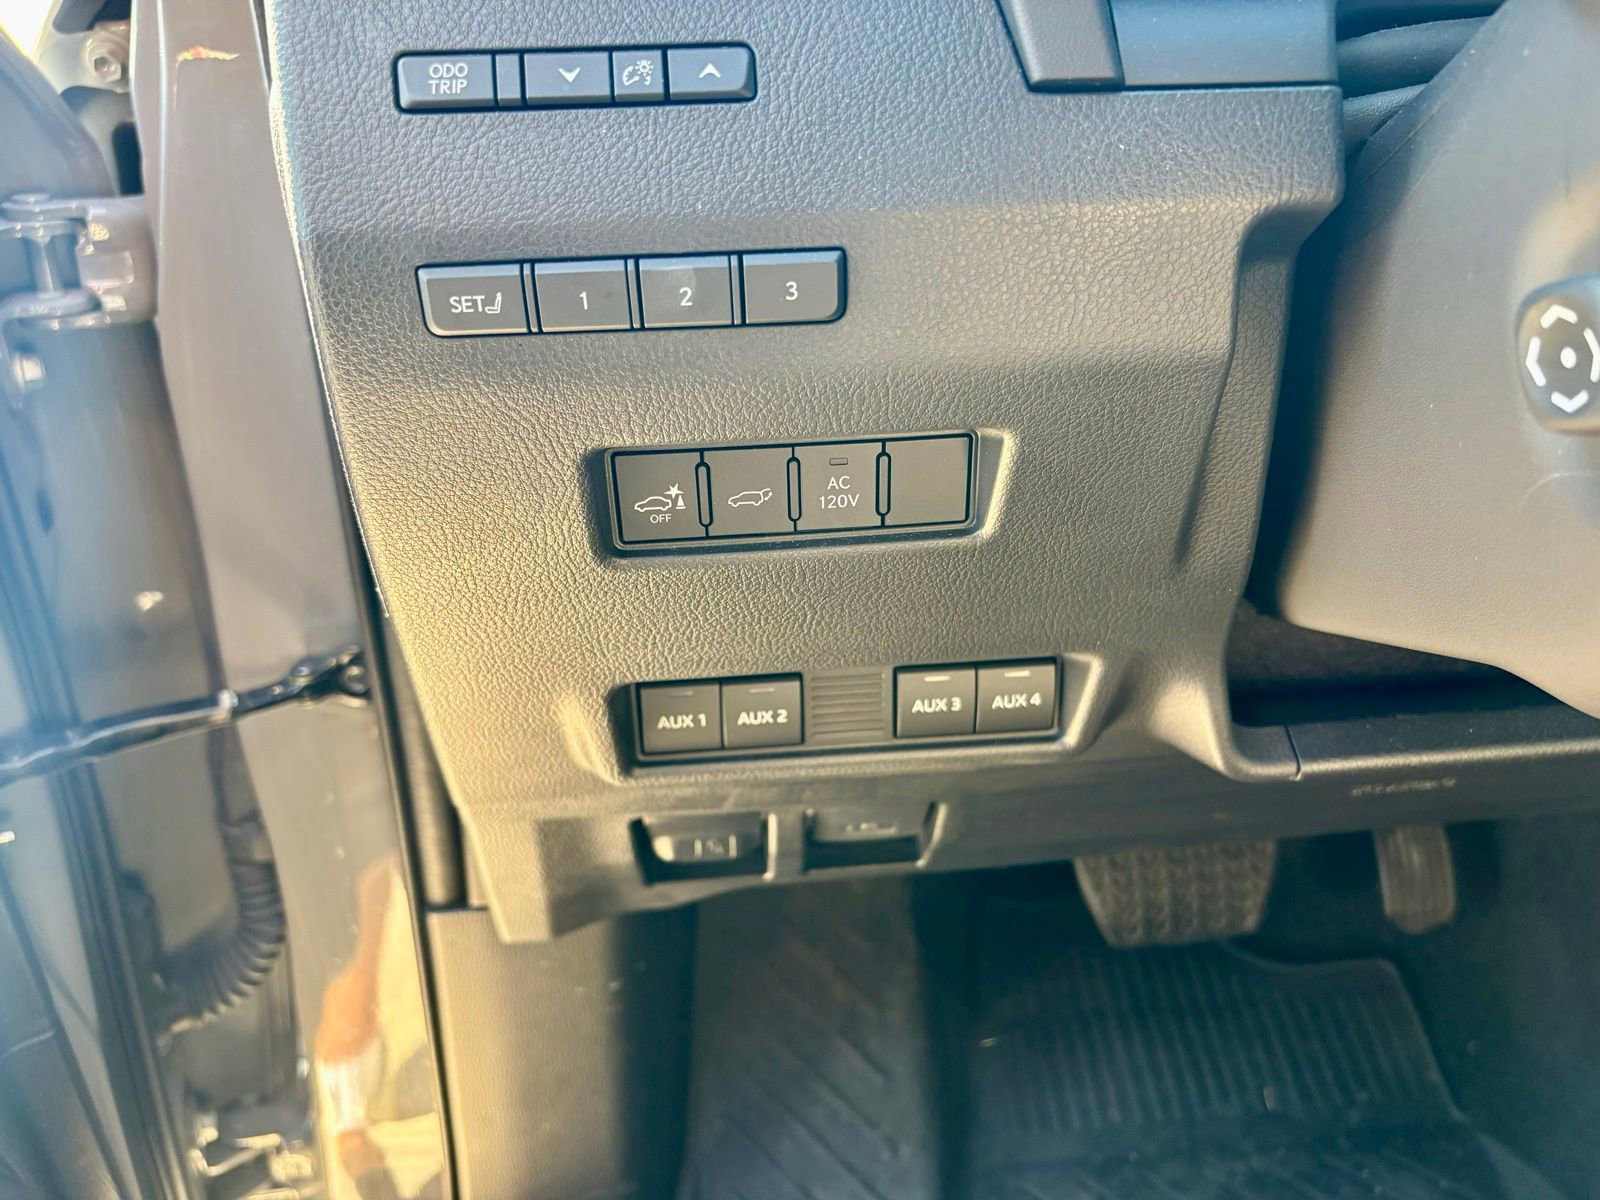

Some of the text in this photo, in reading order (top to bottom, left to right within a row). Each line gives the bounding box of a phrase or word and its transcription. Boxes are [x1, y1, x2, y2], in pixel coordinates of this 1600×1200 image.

[429, 63, 468, 78] ODO
[428, 80, 468, 95] TRIP
[679, 287, 693, 306] 2
[785, 281, 799, 301] 3
[449, 295, 485, 313] SET
[579, 291, 589, 310] 1
[827, 475, 851, 490] AC
[819, 494, 860, 509] 120V
[650, 514, 672, 524] OFF
[911, 697, 961, 714] AUX 3
[991, 692, 1042, 710] AUX 4
[657, 714, 707, 730] AUX 1
[737, 709, 788, 725] AUX 2
